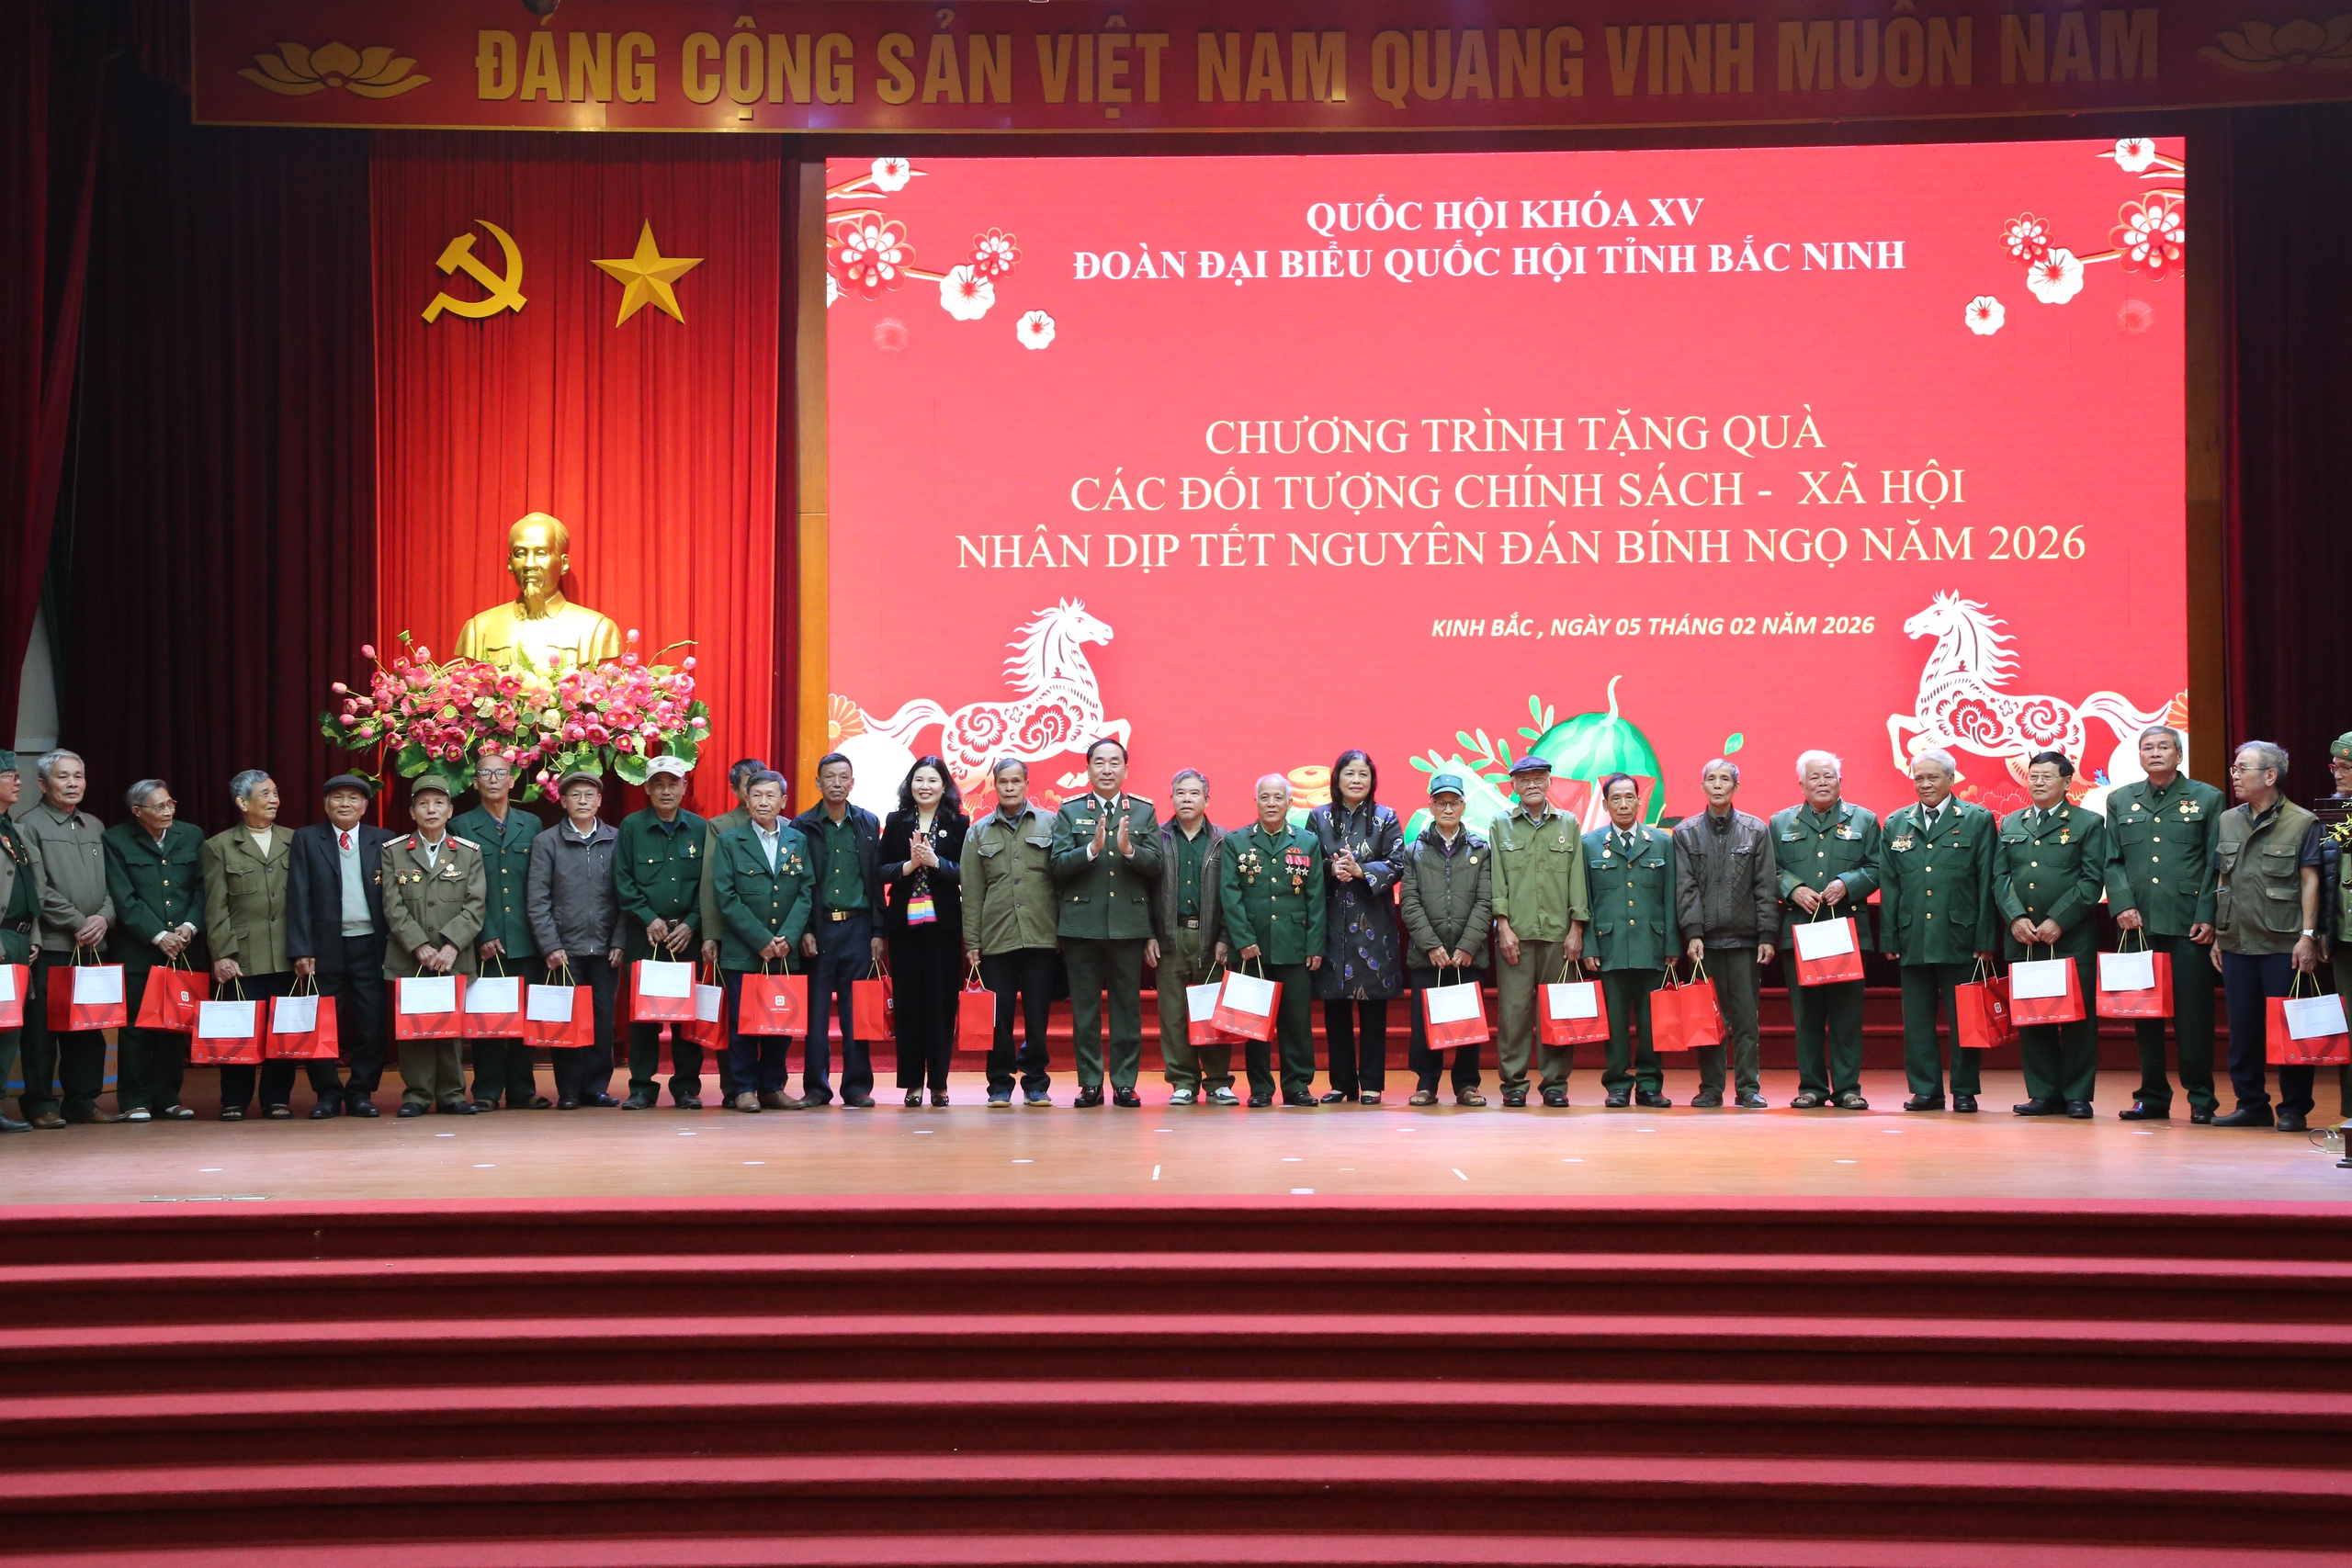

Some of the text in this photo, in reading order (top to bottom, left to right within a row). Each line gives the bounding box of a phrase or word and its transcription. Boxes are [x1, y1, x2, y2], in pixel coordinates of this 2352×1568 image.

[681, 16, 854, 120] CỘNG
[876, 8, 1012, 105] SẢN
[1035, 16, 1170, 119] VIỆT
[1197, 30, 1347, 103] NAM
[1372, 26, 1584, 110] QUANG
[1605, 23, 1755, 97] VINH
[1778, 0, 1973, 91] MUÔN
[2001, 0, 2159, 85] NĂM
[1306, 190, 1705, 238] QUỐC HỘI KHÓA XV
[1072, 234, 1906, 287] ĐOÀN ĐẠI BIỂU QUỐC HỘI TỈNH BẮC NINH
[1205, 403, 1826, 458] CHƯƠNG TRÌNH TẶNG QUÀ
[1070, 466, 1166, 512] CÁC
[1179, 466, 1262, 511] ĐỐI
[1273, 470, 1442, 516] TƯỢNG
[1454, 463, 1605, 509] CHÍNH
[1619, 461, 1745, 508] SÁCH
[1797, 461, 1868, 505] XÃ
[1880, 458, 1966, 511] HỘI
[955, 518, 2086, 574] NHÂN DỊP TẾT NGUYÊN ĐÁN BÍNH NGỌ NĂM 2026
[1431, 618, 1486, 637] KINH
[1490, 611, 1532, 637] BẮC
[1550, 613, 1611, 637] NGÀY
[1615, 616, 1642, 636] 05
[1647, 613, 1725, 636] THÁNG
[1729, 616, 1757, 636] 02
[1761, 611, 1818, 635] NĂM
[1822, 615, 1876, 635] 2026
